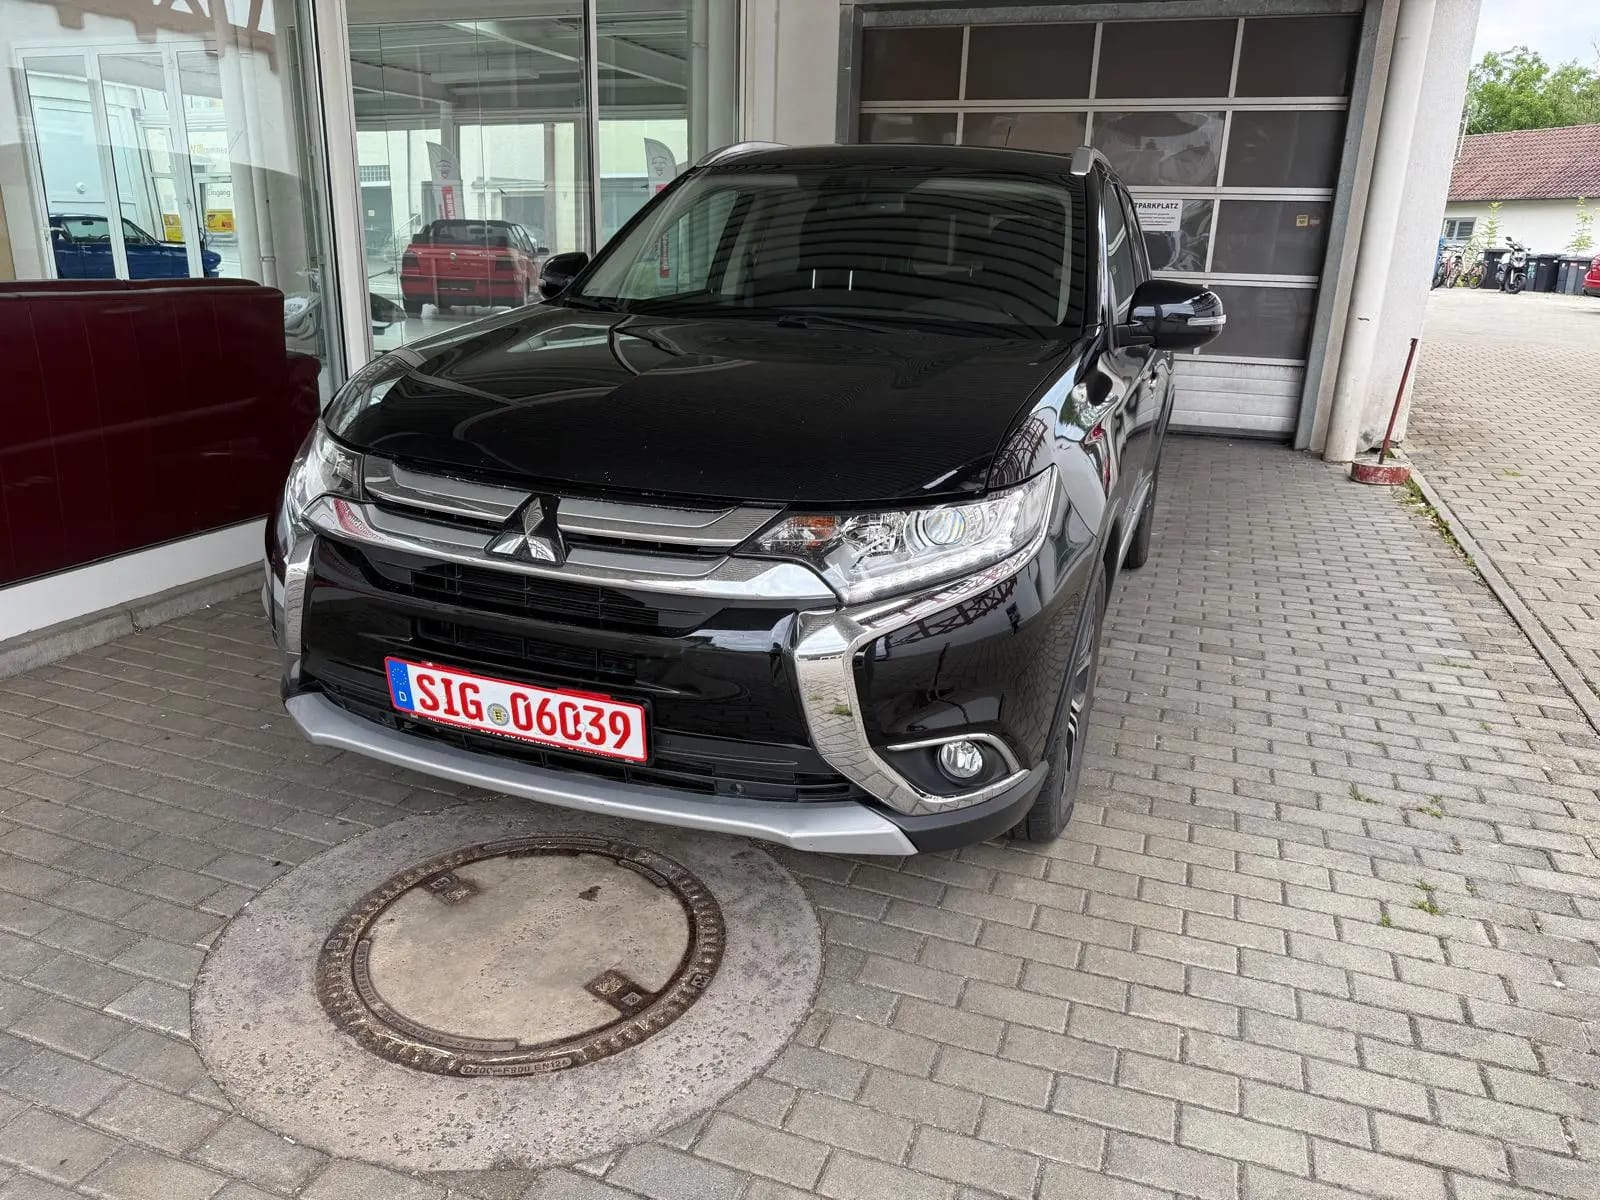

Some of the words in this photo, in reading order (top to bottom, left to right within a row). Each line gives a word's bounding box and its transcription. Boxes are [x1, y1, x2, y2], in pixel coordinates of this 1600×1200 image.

[207, 188, 231, 198] Eingang
[398, 691, 408, 702] D
[416, 673, 484, 722] SIG
[509, 691, 632, 750] 06039
